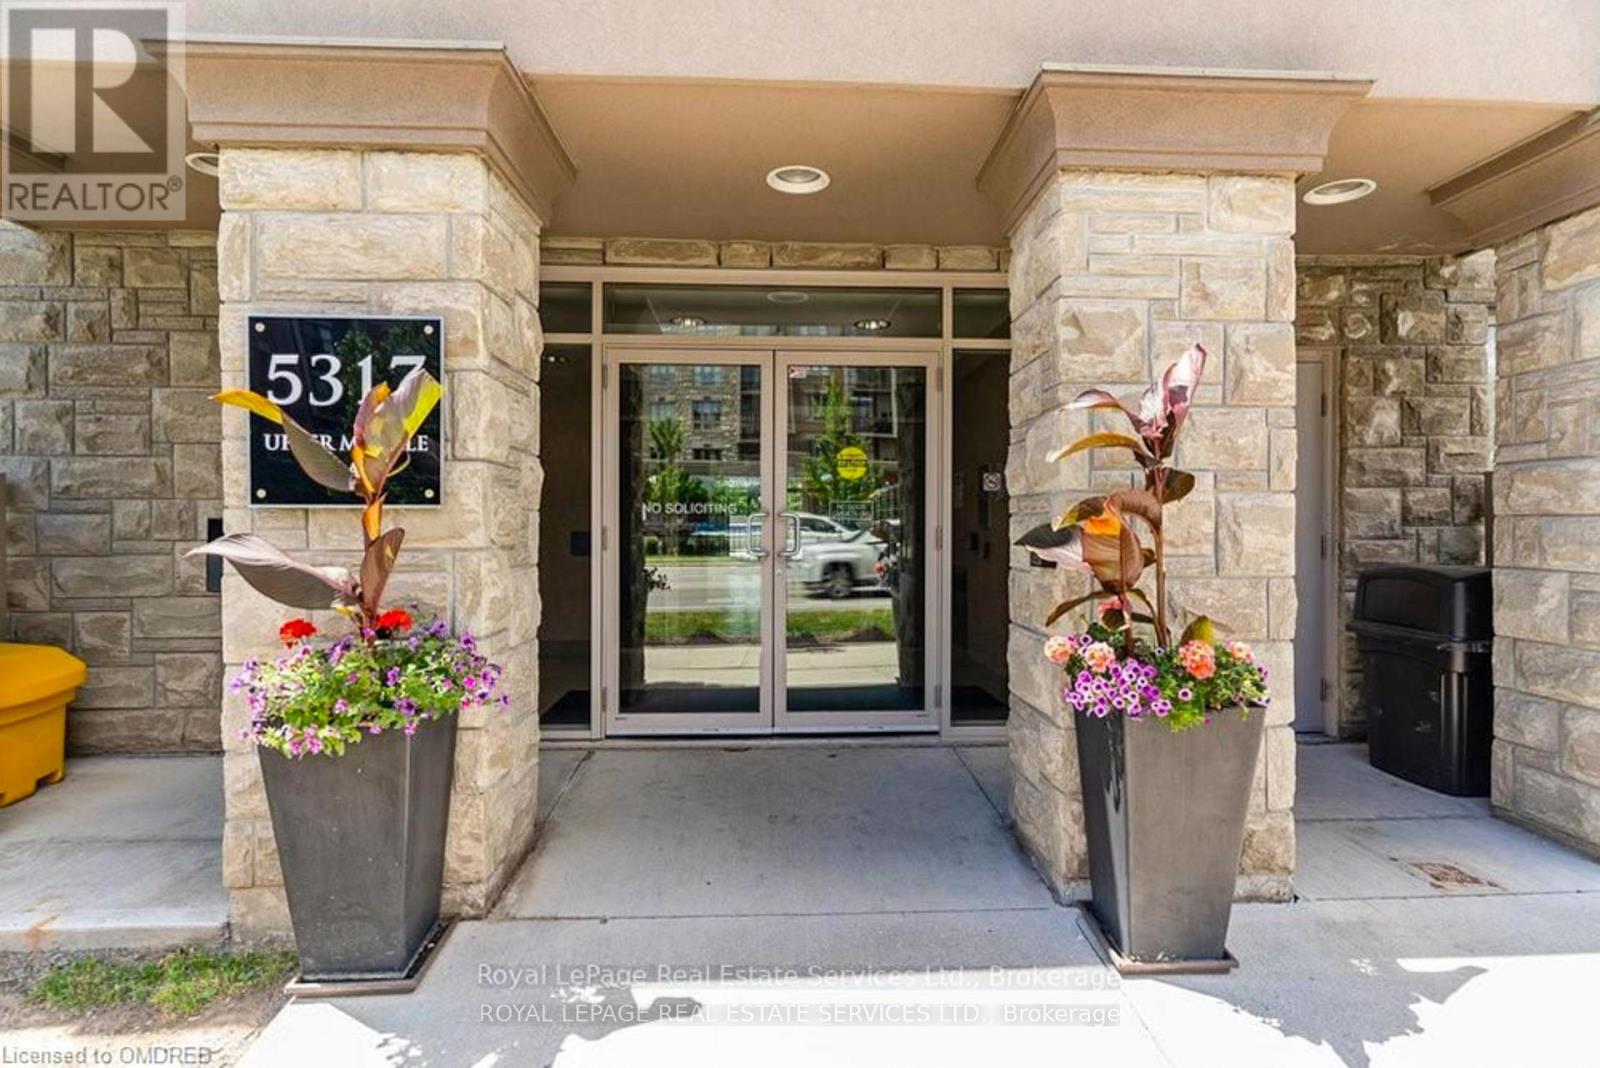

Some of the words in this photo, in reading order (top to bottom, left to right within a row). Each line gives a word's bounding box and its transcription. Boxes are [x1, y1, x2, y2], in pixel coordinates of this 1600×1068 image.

[266, 353, 427, 407] 5317
[339, 433, 429, 452] MLE
[642, 502, 662, 514] NO
[664, 502, 738, 515] SOLICITING
